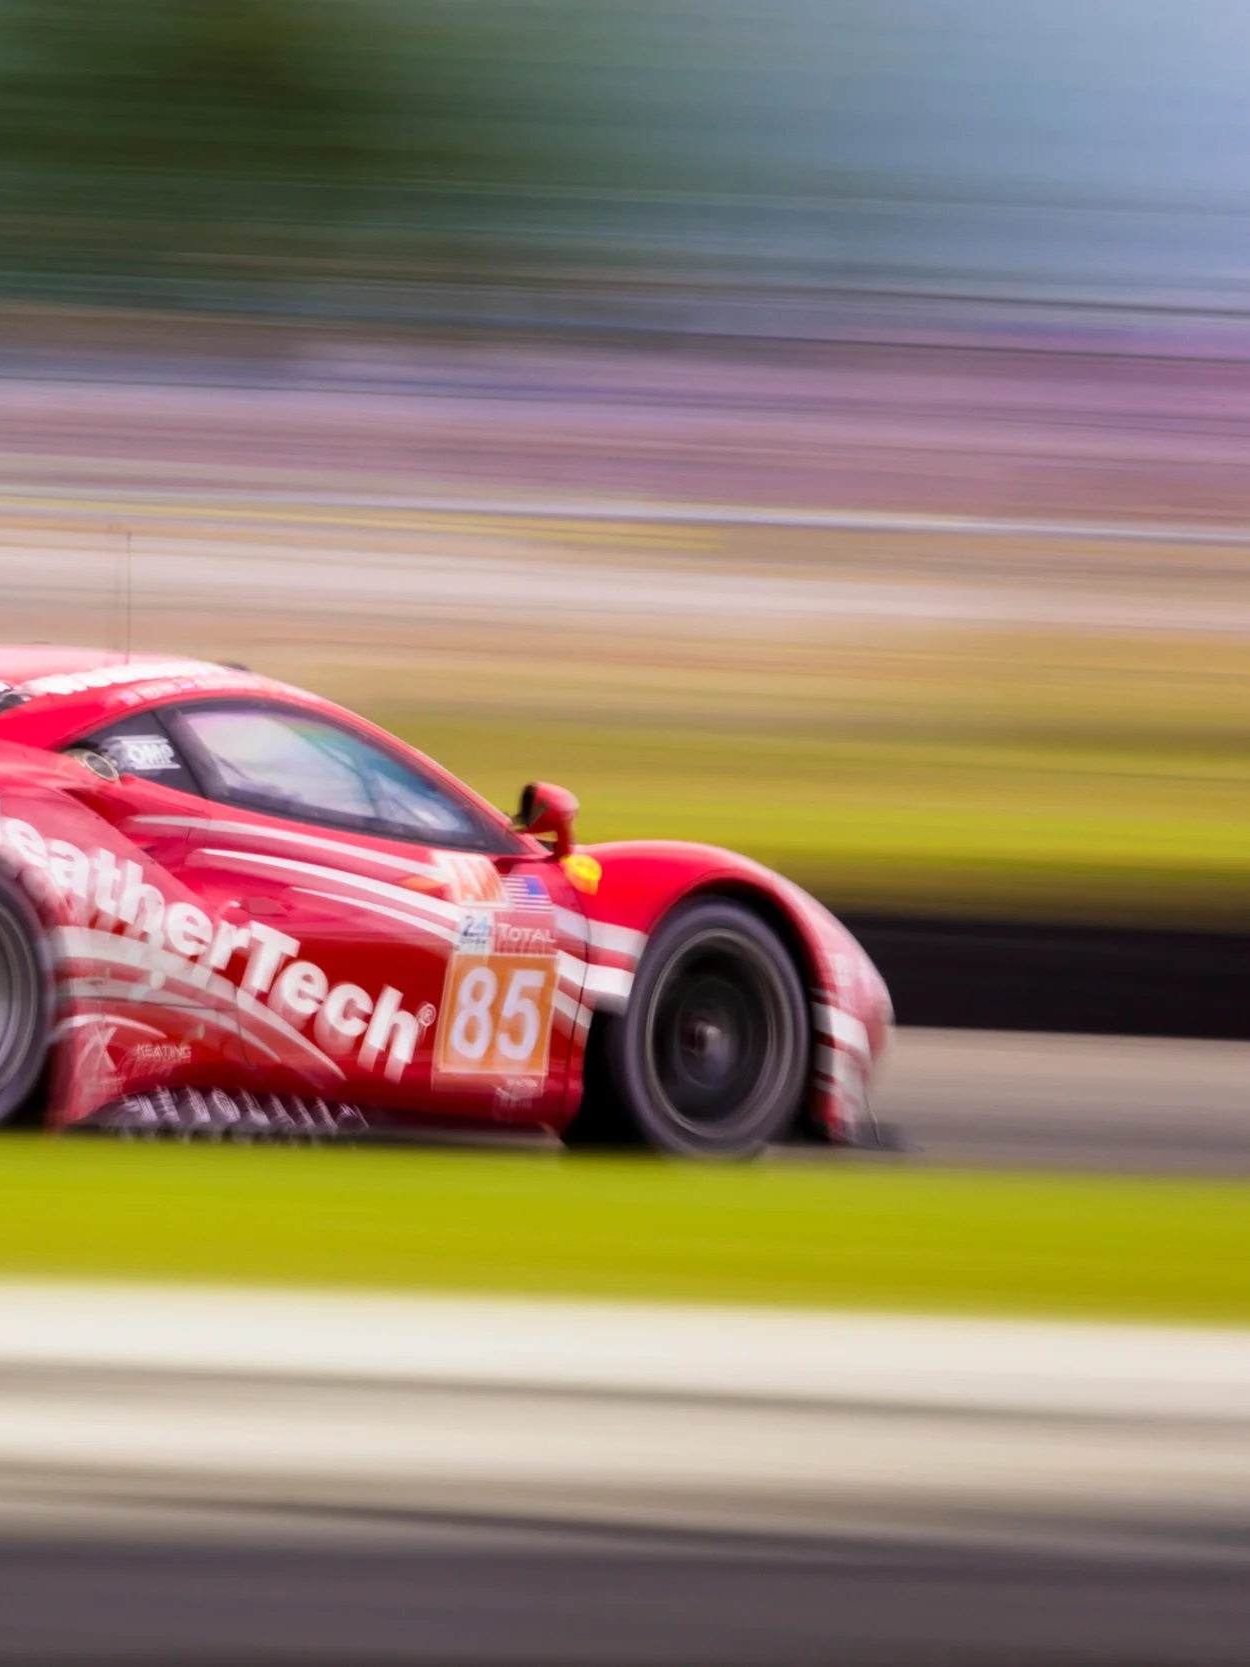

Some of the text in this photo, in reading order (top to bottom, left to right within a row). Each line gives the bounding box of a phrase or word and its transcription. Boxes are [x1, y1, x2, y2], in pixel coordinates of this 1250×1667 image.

[498, 923, 557, 945] TOTAL
[451, 966, 547, 1061] 85
[136, 1042, 193, 1059] KEATING
